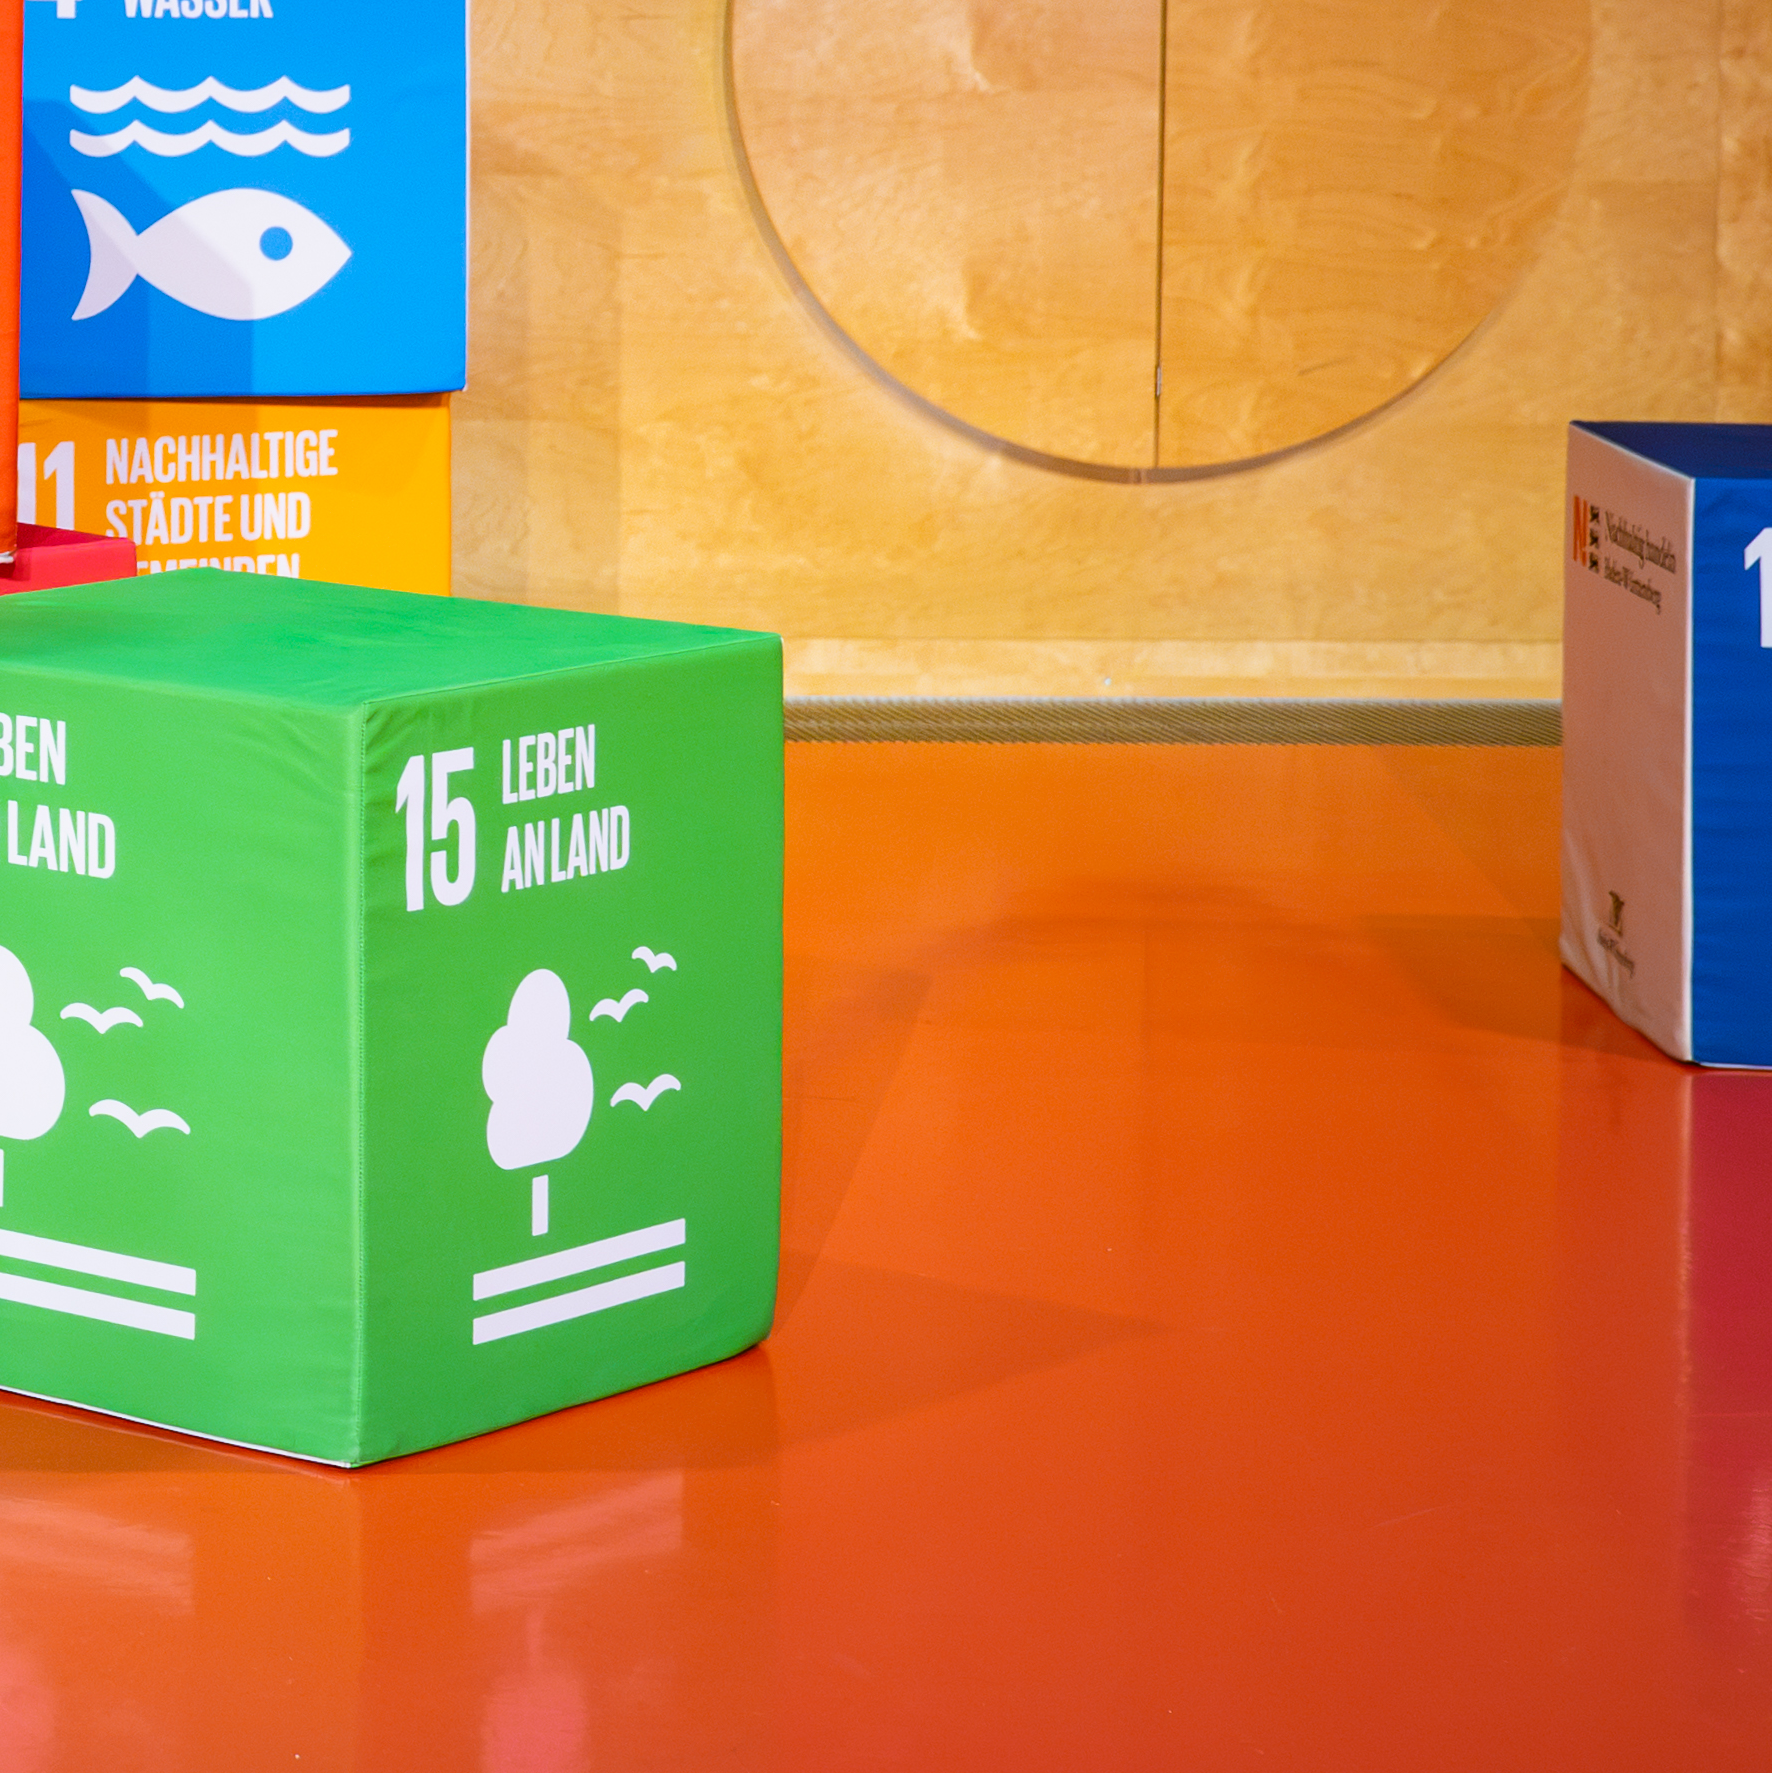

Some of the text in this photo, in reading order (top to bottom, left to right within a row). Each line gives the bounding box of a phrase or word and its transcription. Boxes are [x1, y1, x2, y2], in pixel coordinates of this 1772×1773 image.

[106, 429, 338, 485] NACHHALTIGE
[106, 490, 311, 546] STÄDTE UND
[502, 724, 595, 804] LEBEN
[8, 799, 115, 879] LAND
[395, 746, 476, 912] 15
[501, 805, 630, 893] AN LAND
